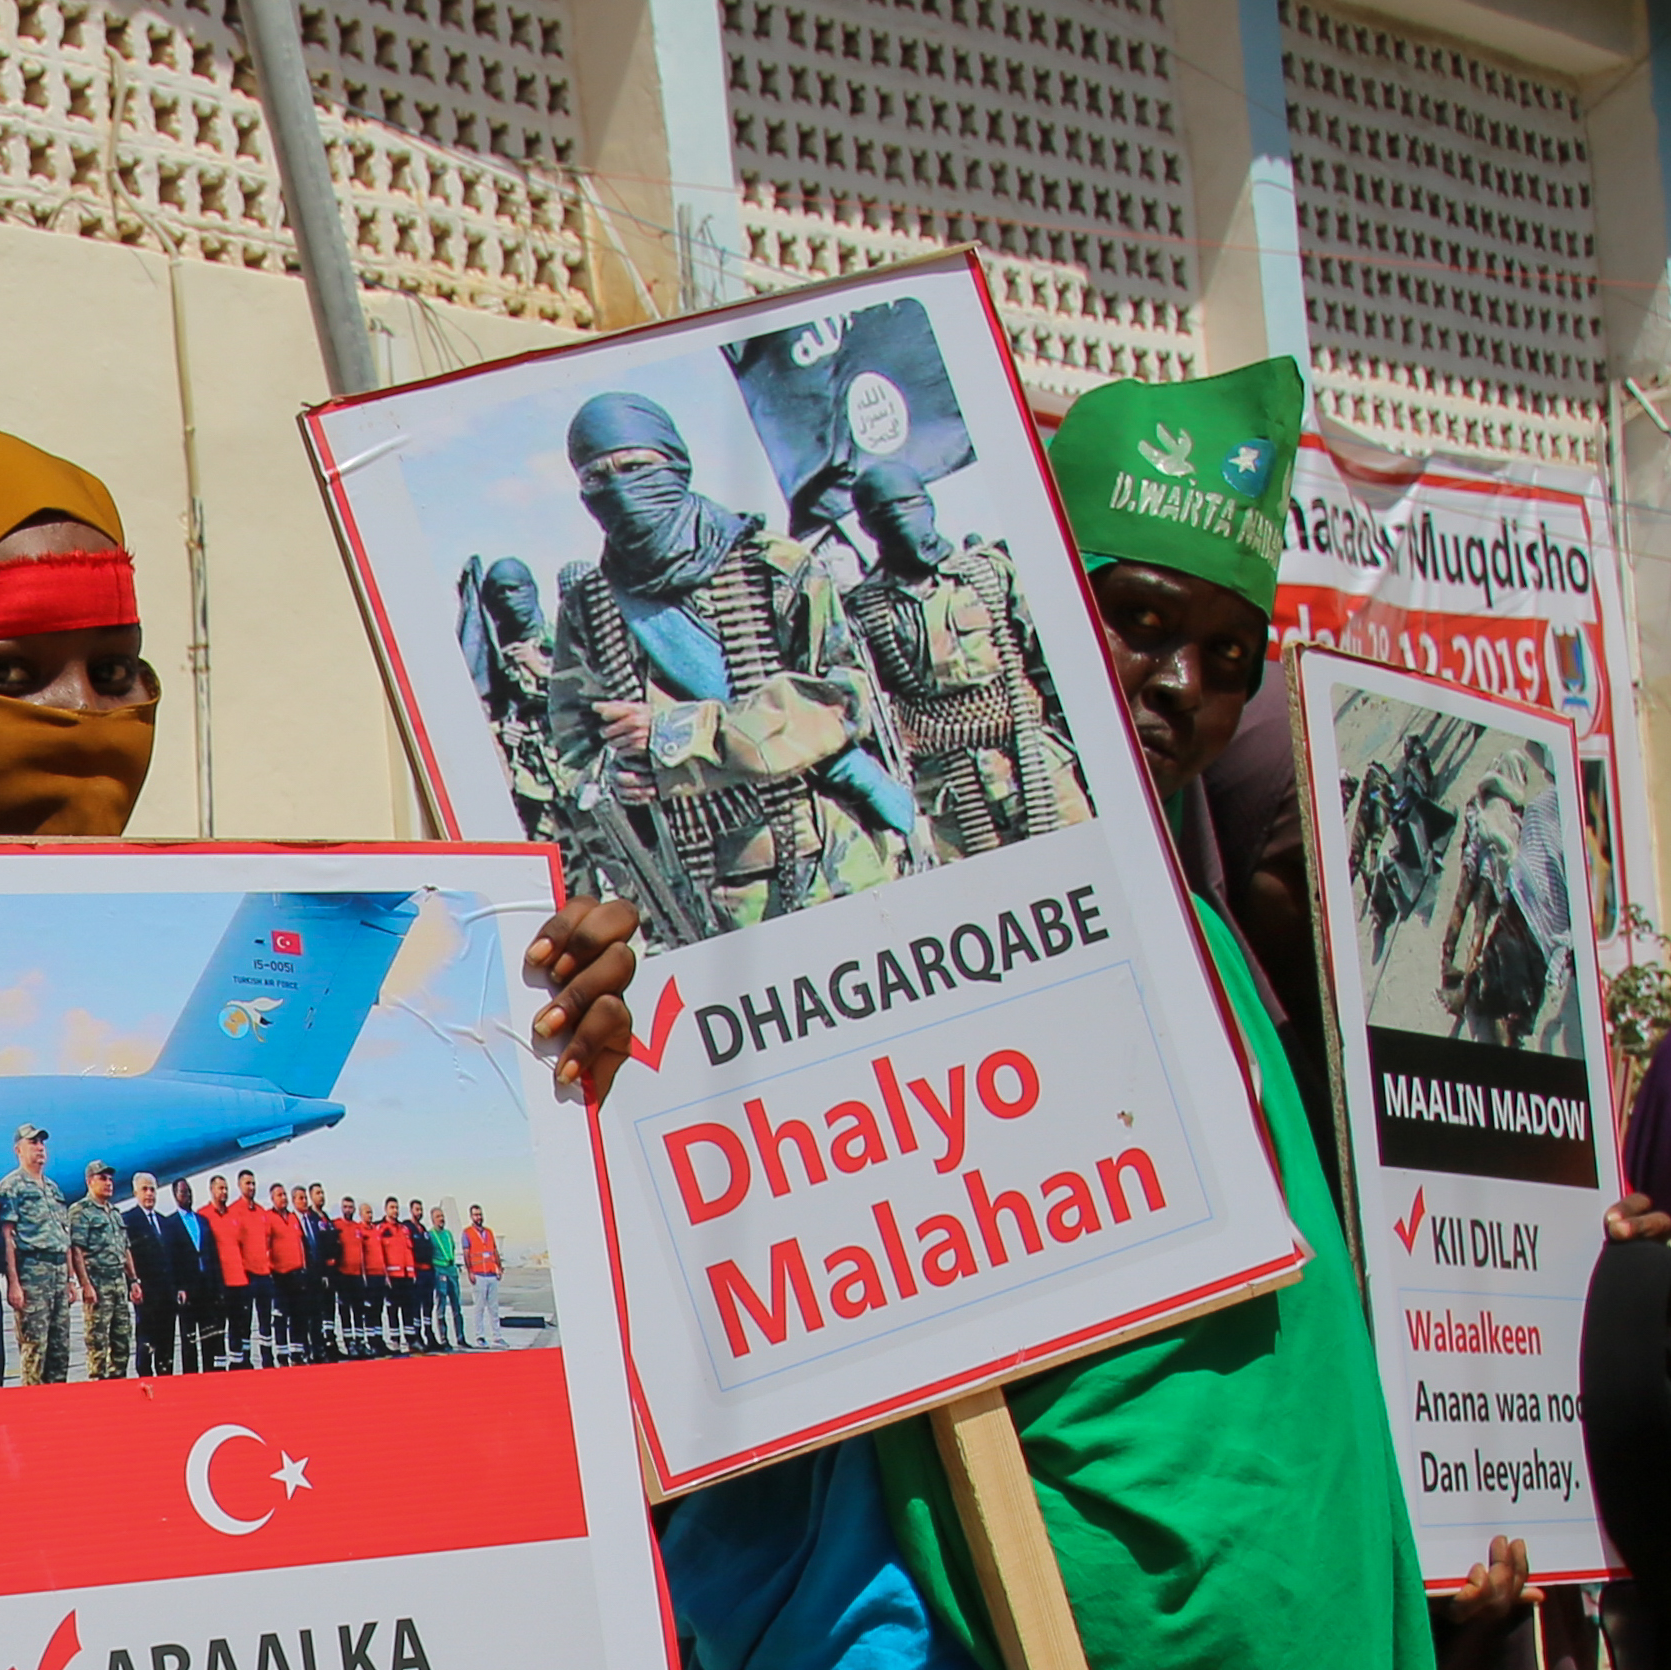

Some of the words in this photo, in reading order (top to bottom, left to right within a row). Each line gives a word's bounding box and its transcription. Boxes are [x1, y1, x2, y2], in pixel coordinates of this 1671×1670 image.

[1409, 512, 1590, 609] Muqdisho
[252, 959, 294, 973] 15-0051
[694, 885, 1109, 1067] DHAGARQABE
[662, 1049, 1041, 1227] Dhalyo
[1382, 1072, 1487, 1129] MAALIN
[1491, 1087, 1586, 1141] MADOW
[705, 1147, 1168, 1359] Malahan
[1431, 1215, 1466, 1266] KII
[1469, 1217, 1539, 1271] DILAY
[1405, 1309, 1542, 1356] Walaalkeen
[1415, 1380, 1490, 1422] Anana
[1496, 1391, 1541, 1422] waa
[1420, 1450, 1468, 1493] Dan
[1475, 1447, 1580, 1504] leeyahay.
